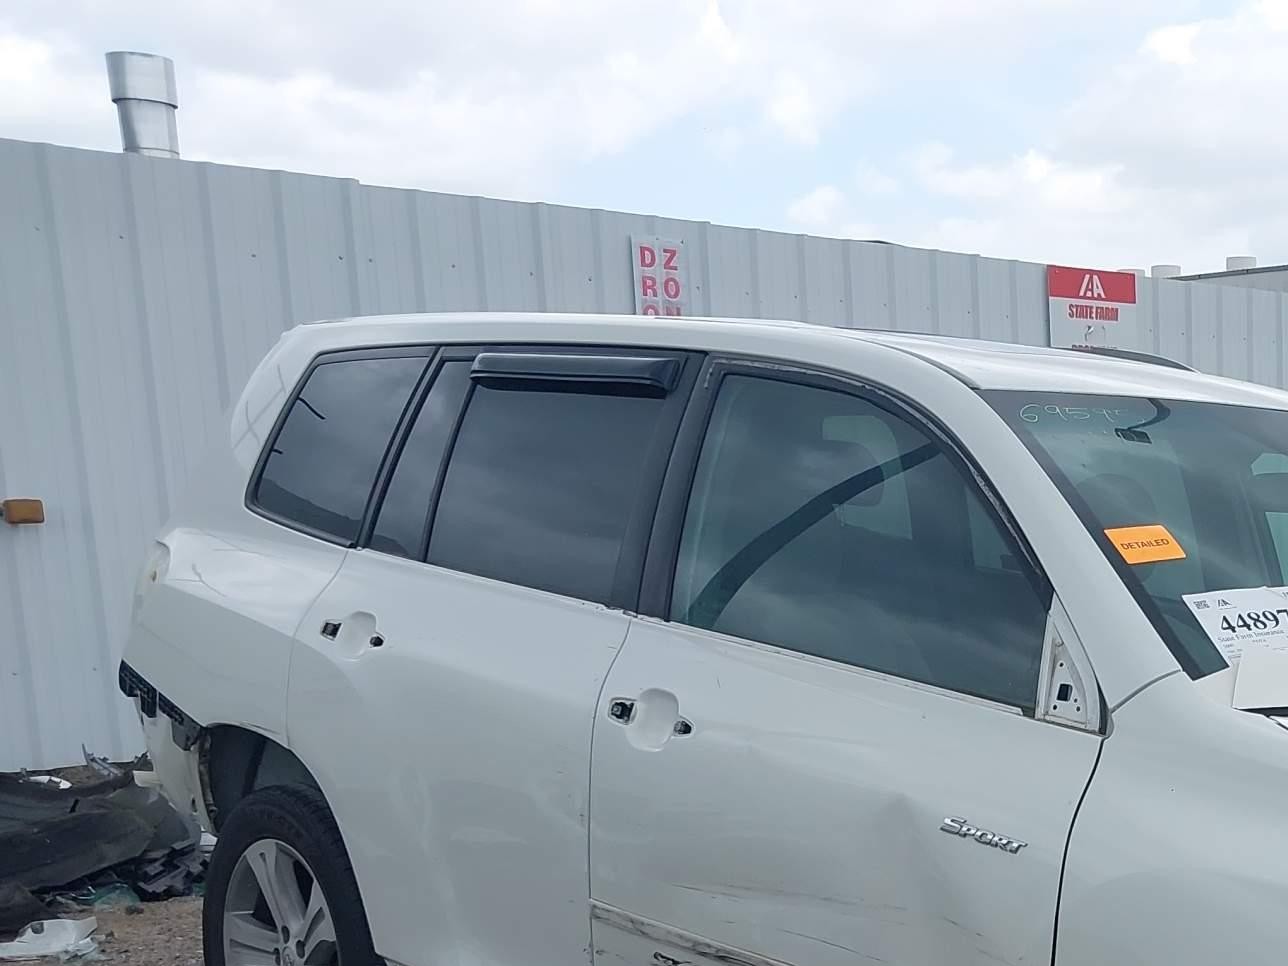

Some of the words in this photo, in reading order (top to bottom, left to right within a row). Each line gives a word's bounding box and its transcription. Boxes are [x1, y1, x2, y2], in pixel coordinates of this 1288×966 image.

[1068, 303, 1094, 320] STATE
[1095, 305, 1119, 321] FARM
[1120, 538, 1170, 550] DETAILED
